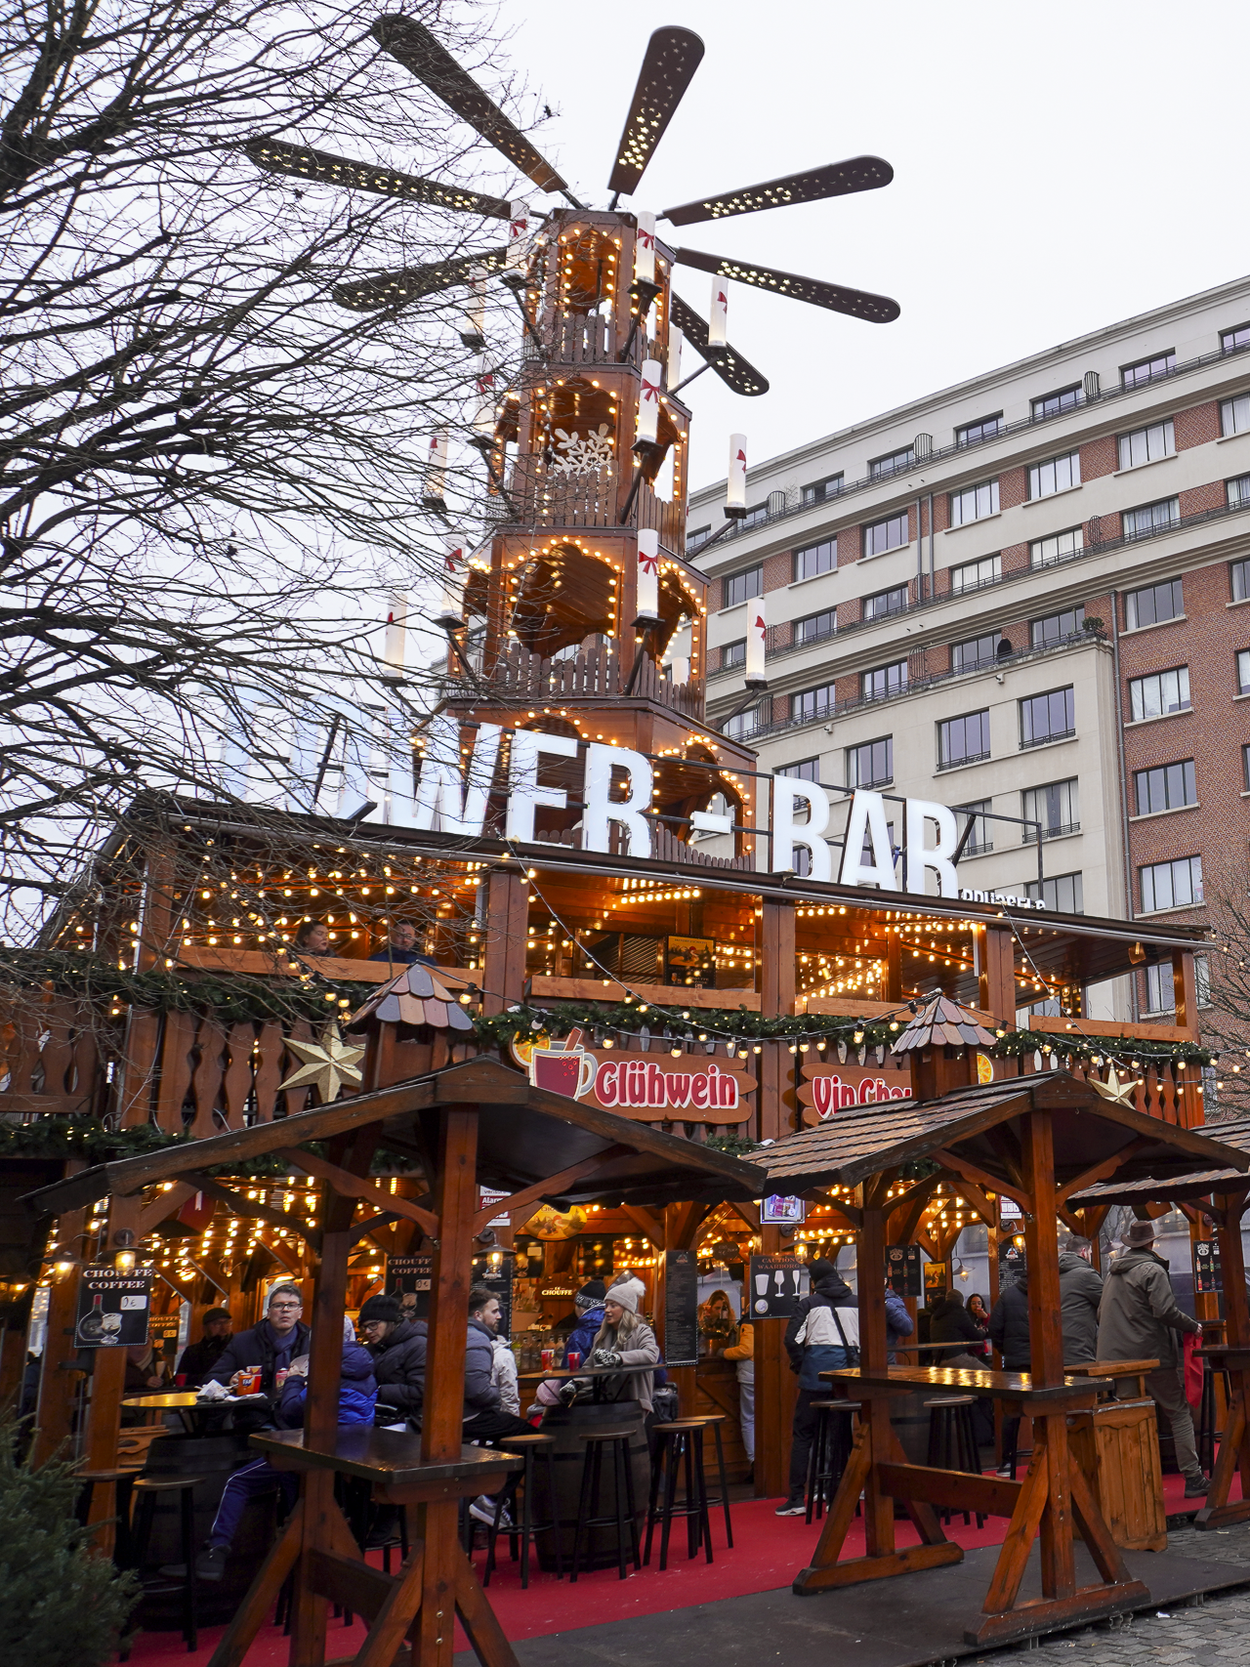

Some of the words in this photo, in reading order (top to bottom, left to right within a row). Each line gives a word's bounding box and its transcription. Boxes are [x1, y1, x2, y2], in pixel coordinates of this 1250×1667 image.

[196, 672, 653, 858] TOWER
[772, 774, 959, 899] BAR
[593, 1059, 739, 1109] Glühwein
[811, 1074, 858, 1119] Vin
[857, 1077, 912, 1104] Cha
[82, 1268, 153, 1278] CHOFE
[387, 1258, 432, 1266] CHOUFF
[88, 1280, 145, 1290] COFFEE
